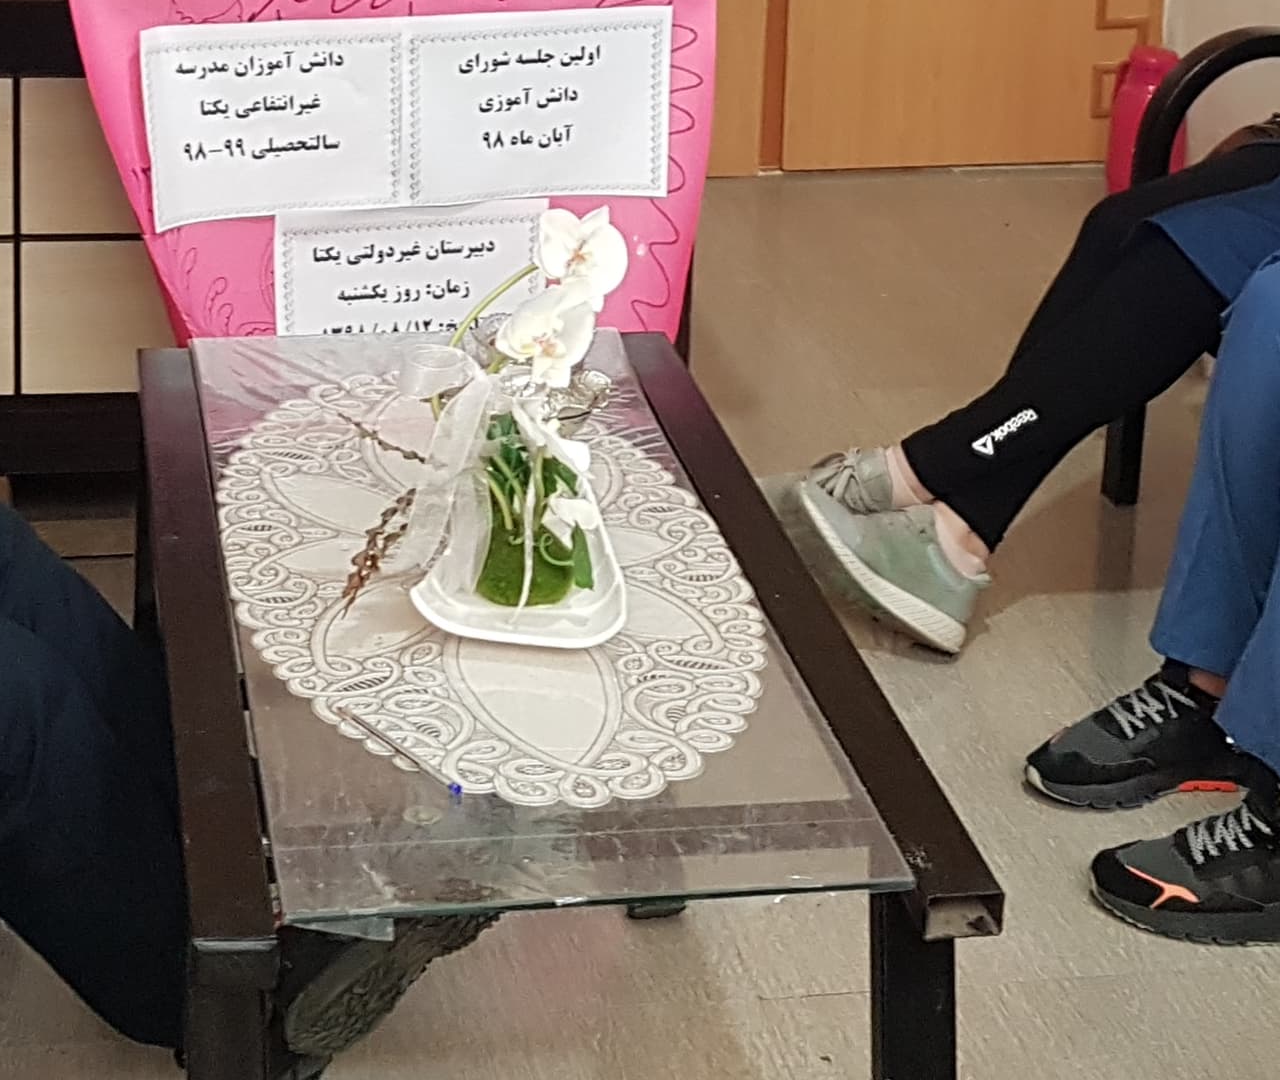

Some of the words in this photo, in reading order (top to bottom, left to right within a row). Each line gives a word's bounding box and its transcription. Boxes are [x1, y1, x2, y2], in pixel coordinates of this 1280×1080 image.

[234, 50, 294, 77] آموزان
[300, 50, 345, 74] دانش
[458, 50, 511, 75] شورای
[516, 48, 555, 69] جلسه
[560, 44, 602, 67] اولین
[175, 62, 230, 80] مدرسه
[199, 98, 230, 120] یکتا
[234, 93, 322, 119] غیرانتفاعی
[478, 87, 533, 113] آموزی
[536, 86, 579, 109] دانش
[250, 134, 341, 160] سالتحصیلی
[482, 130, 505, 150] ۹۸
[510, 129, 535, 146] ماه
[537, 123, 574, 149] آبان
[312, 246, 342, 266] یکتا
[345, 241, 421, 266] غیردولتی
[425, 238, 496, 261] دبیرستان
[336, 283, 389, 306] یکشنبه
[393, 286, 421, 304] روز
[425, 277, 471, 301] زمان:
